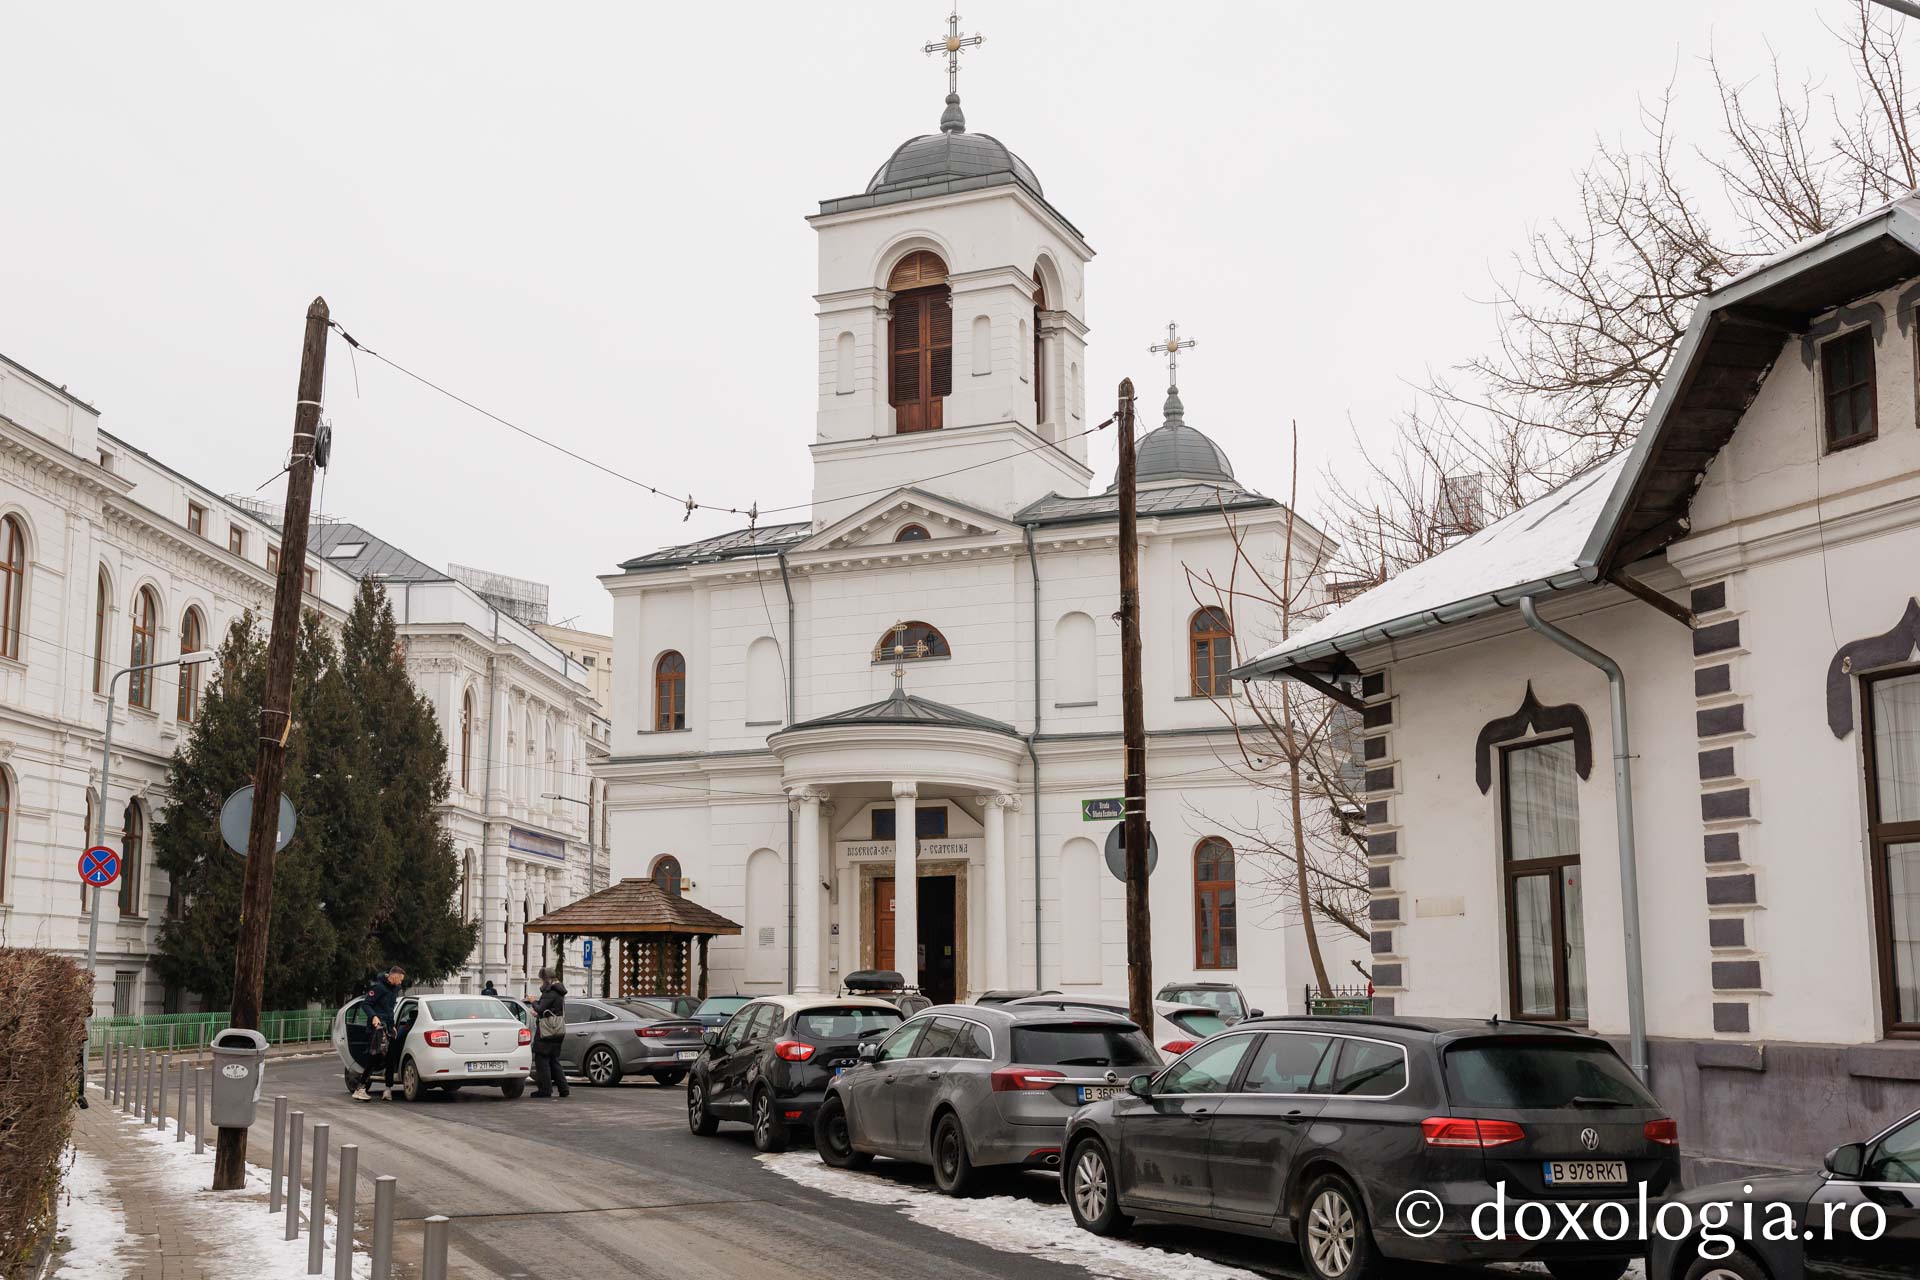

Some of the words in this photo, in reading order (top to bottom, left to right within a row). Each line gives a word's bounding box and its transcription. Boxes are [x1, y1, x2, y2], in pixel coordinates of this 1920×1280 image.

[585, 943, 591, 959] P
[1085, 1088, 1093, 1100] B
[1553, 1163, 1564, 1181] B
